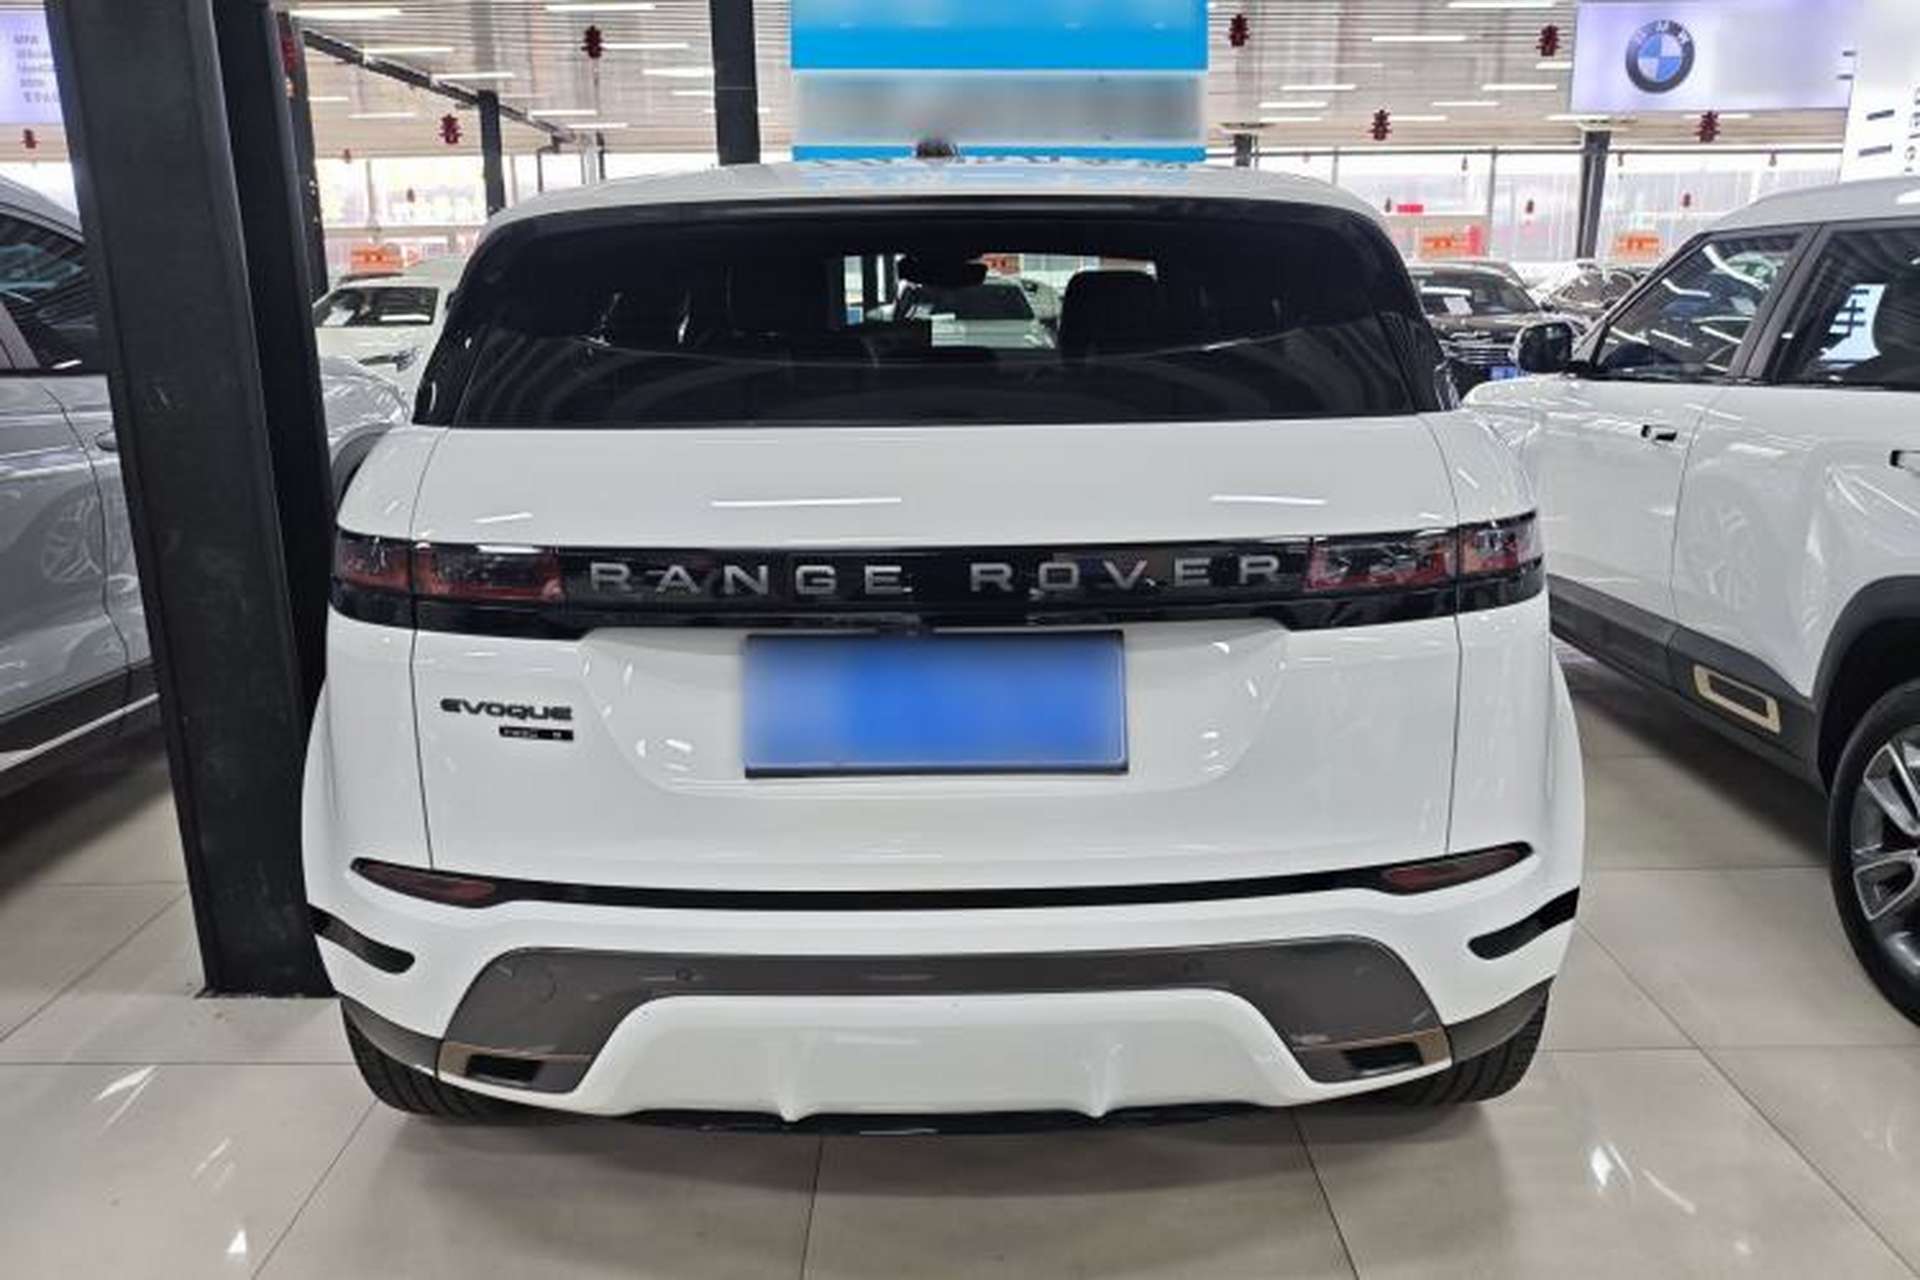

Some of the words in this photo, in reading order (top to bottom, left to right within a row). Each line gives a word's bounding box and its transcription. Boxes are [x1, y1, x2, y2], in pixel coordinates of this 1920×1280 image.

[590, 562, 902, 596] RANGE
[969, 555, 1280, 592] ROVER
[440, 698, 573, 721] EVOQUE
